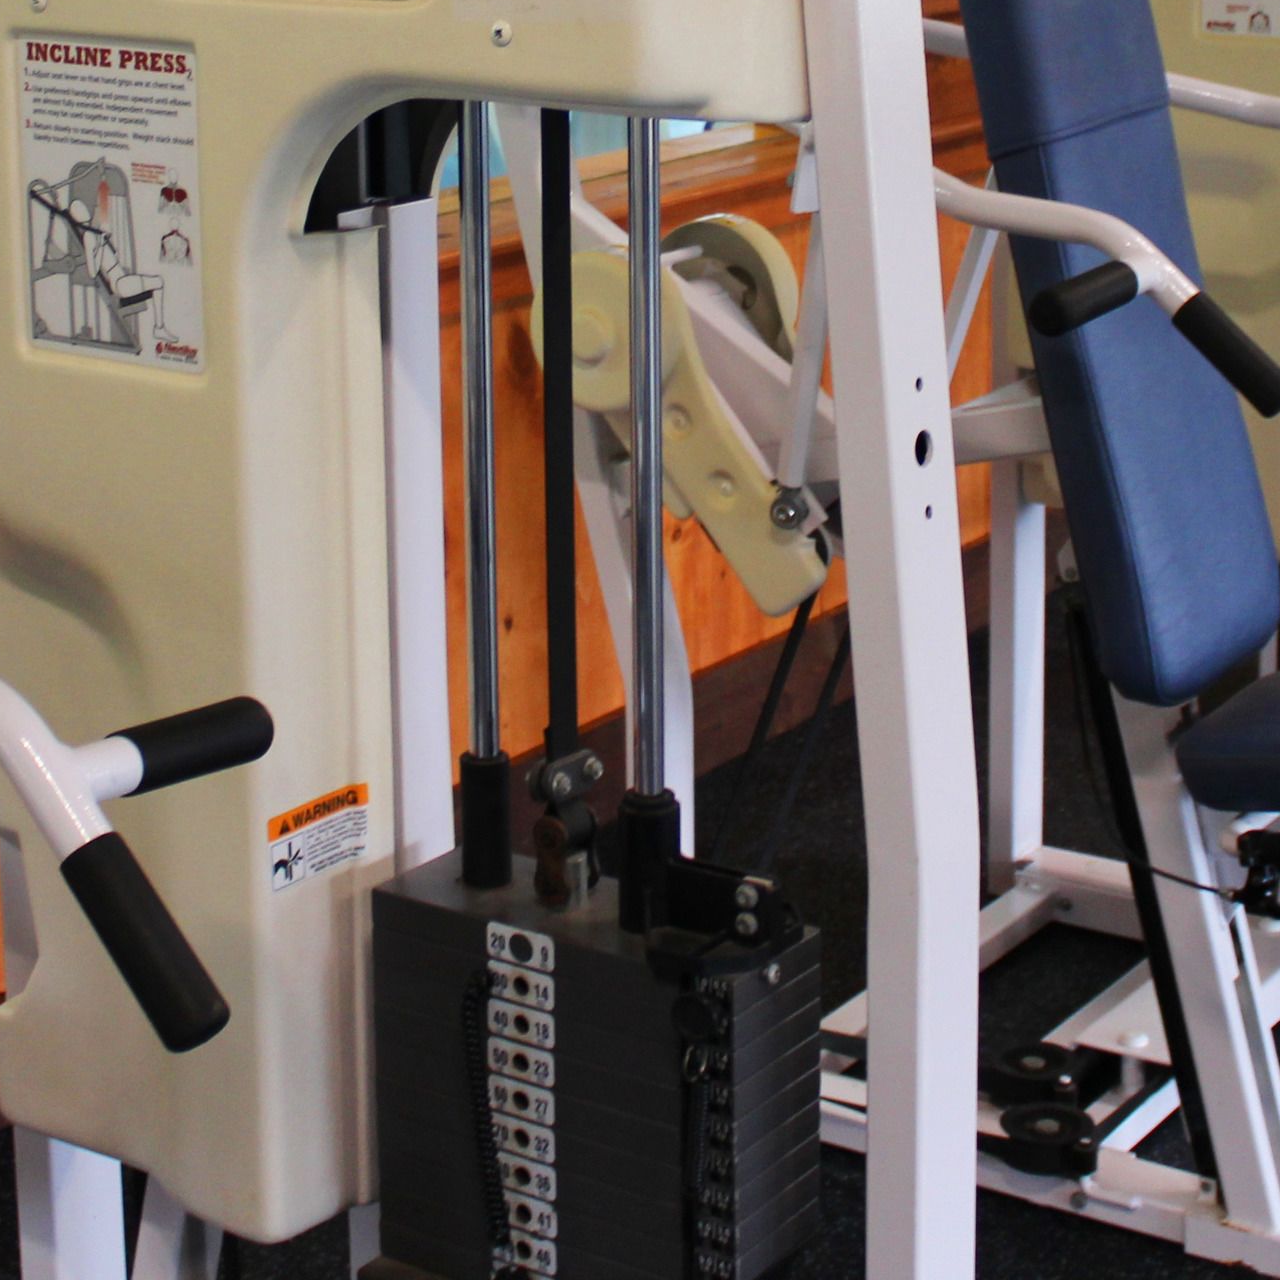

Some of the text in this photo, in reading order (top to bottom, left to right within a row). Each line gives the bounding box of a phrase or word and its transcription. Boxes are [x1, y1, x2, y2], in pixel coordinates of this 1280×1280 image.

[26, 42, 187, 74] INCLINE PRESS
[292, 790, 359, 830] WARNING
[491, 932, 506, 951] 20
[540, 946, 549, 963] 9
[535, 985, 549, 1001] 14
[493, 1010, 509, 1028] 40
[535, 1022, 549, 1040] 18
[534, 1060, 549, 1079] 23
[535, 1098, 549, 1118] 27
[534, 1136, 550, 1153] 32
[538, 1212, 552, 1229] 41
